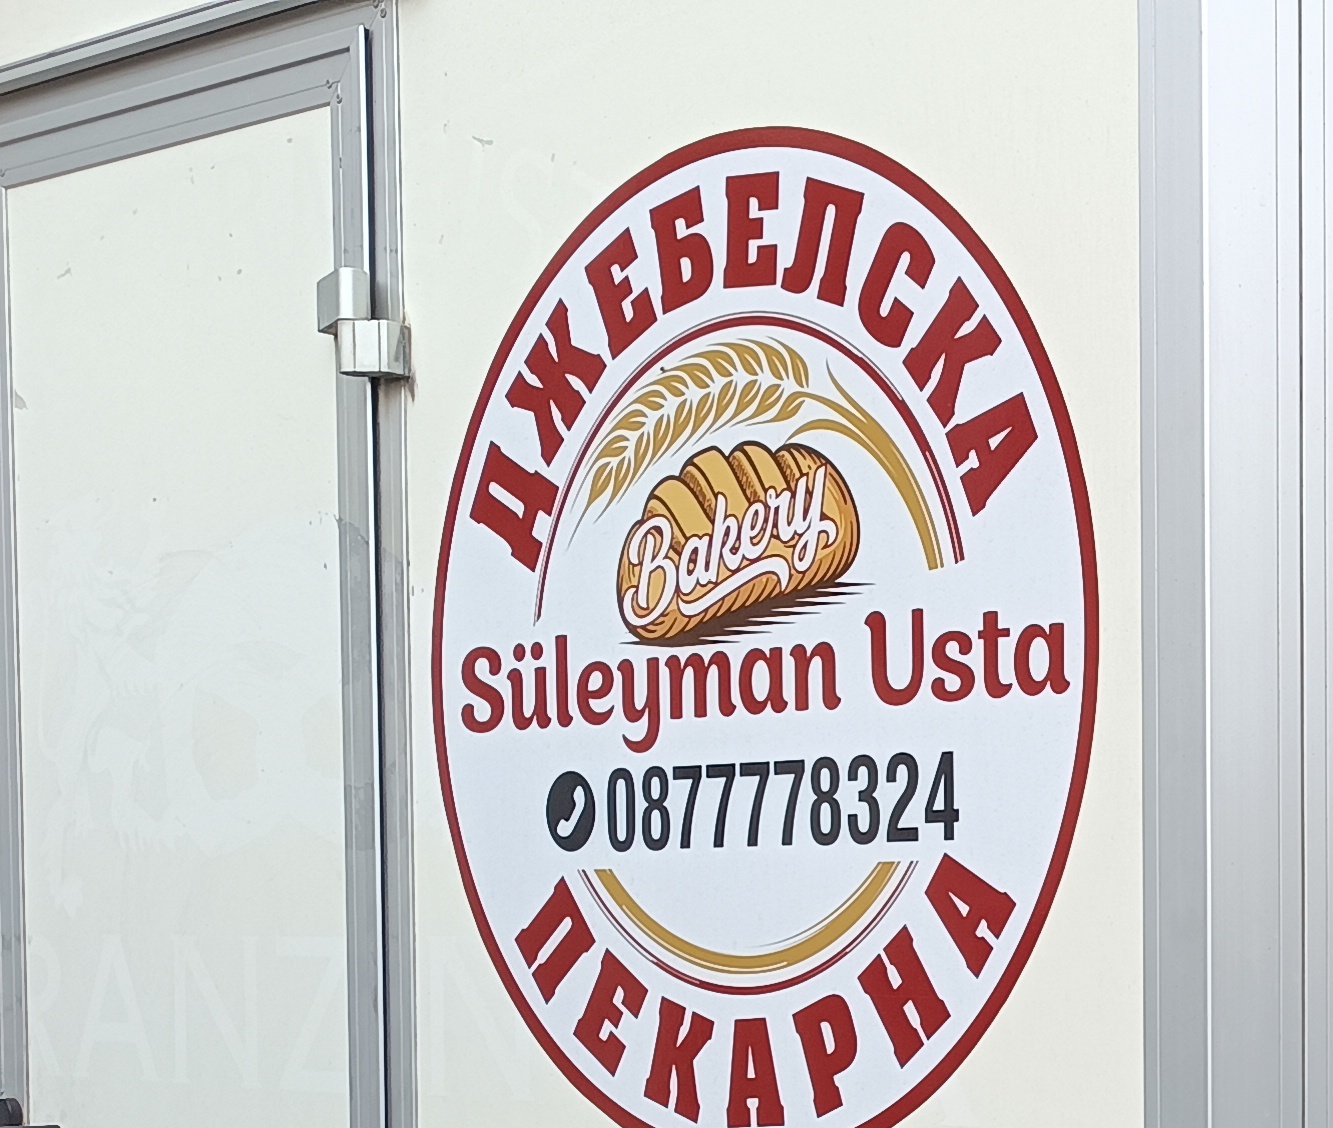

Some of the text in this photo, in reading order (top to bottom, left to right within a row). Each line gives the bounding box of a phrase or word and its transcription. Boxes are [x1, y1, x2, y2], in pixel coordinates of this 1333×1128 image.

[469, 171, 1038, 572] ДЖЕБЕЛСКА
[623, 464, 838, 626] Bakery
[461, 608, 1070, 753] Süleyman Usta
[606, 751, 959, 852] 0877778324
[514, 853, 1017, 1128] ПЕКАРНА
